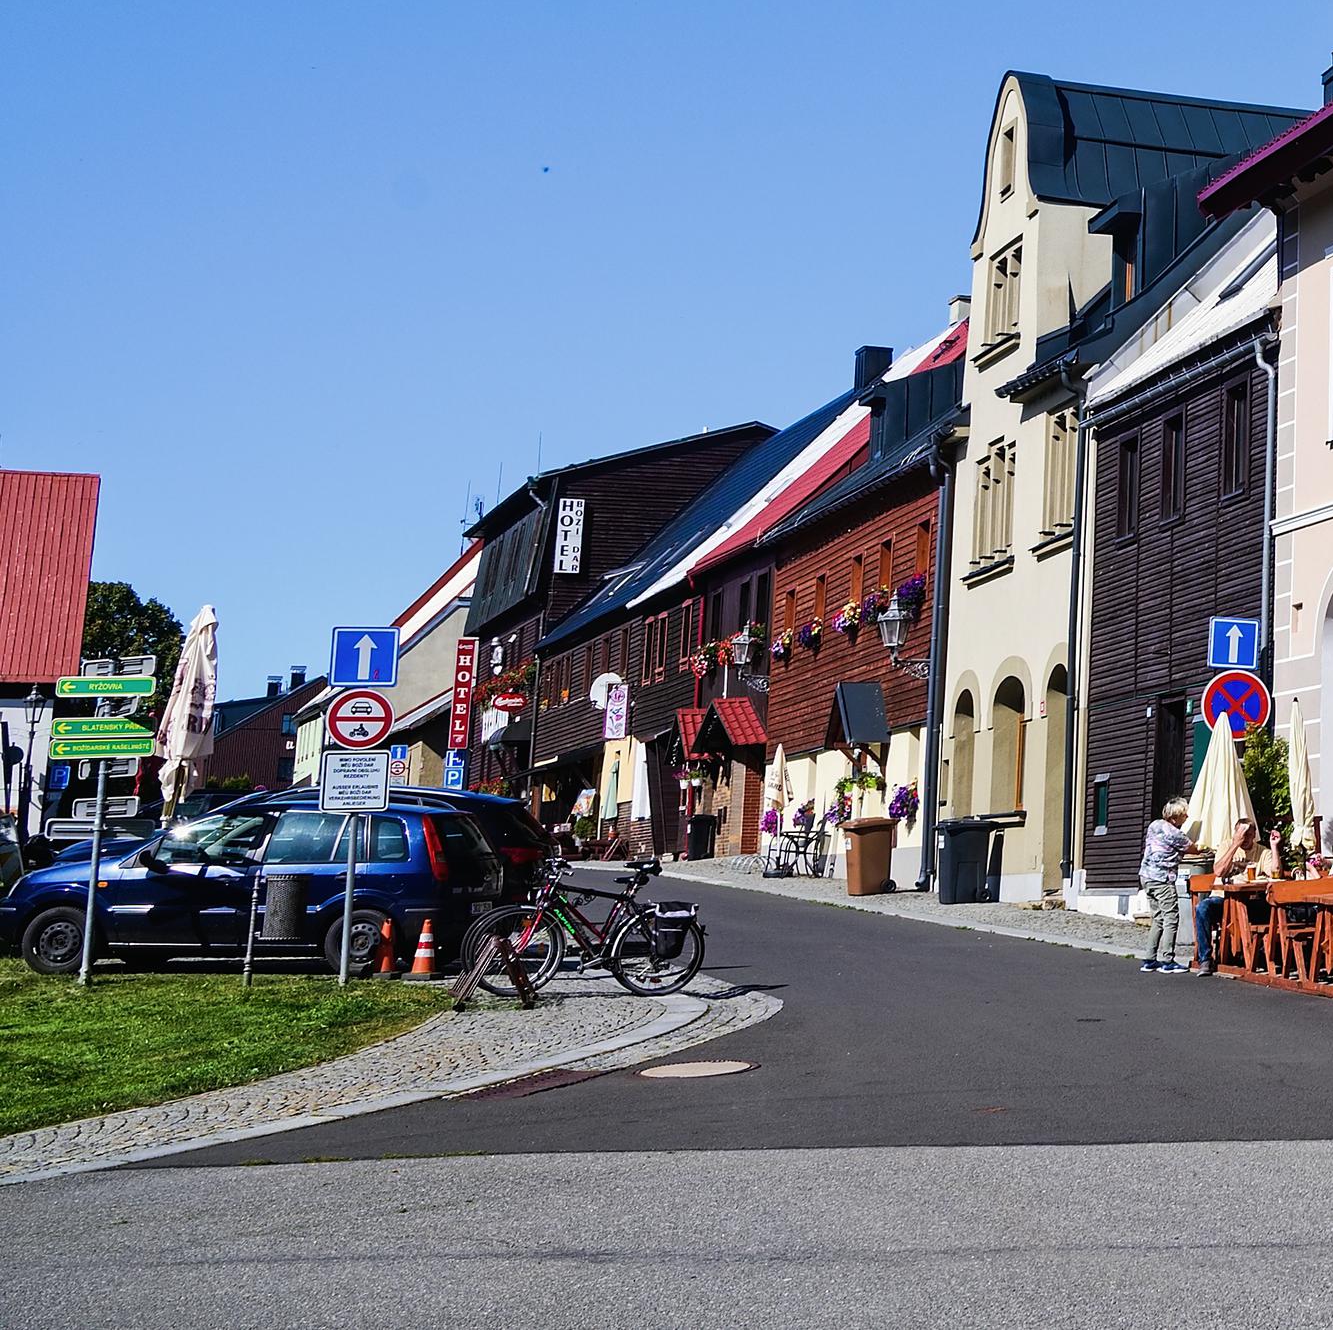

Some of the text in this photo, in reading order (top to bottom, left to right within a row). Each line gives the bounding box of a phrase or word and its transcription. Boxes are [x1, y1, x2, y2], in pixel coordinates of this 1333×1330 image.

[558, 500, 574, 571] HOTEL
[572, 546, 580, 572] DAR
[454, 655, 472, 731] HOTEL
